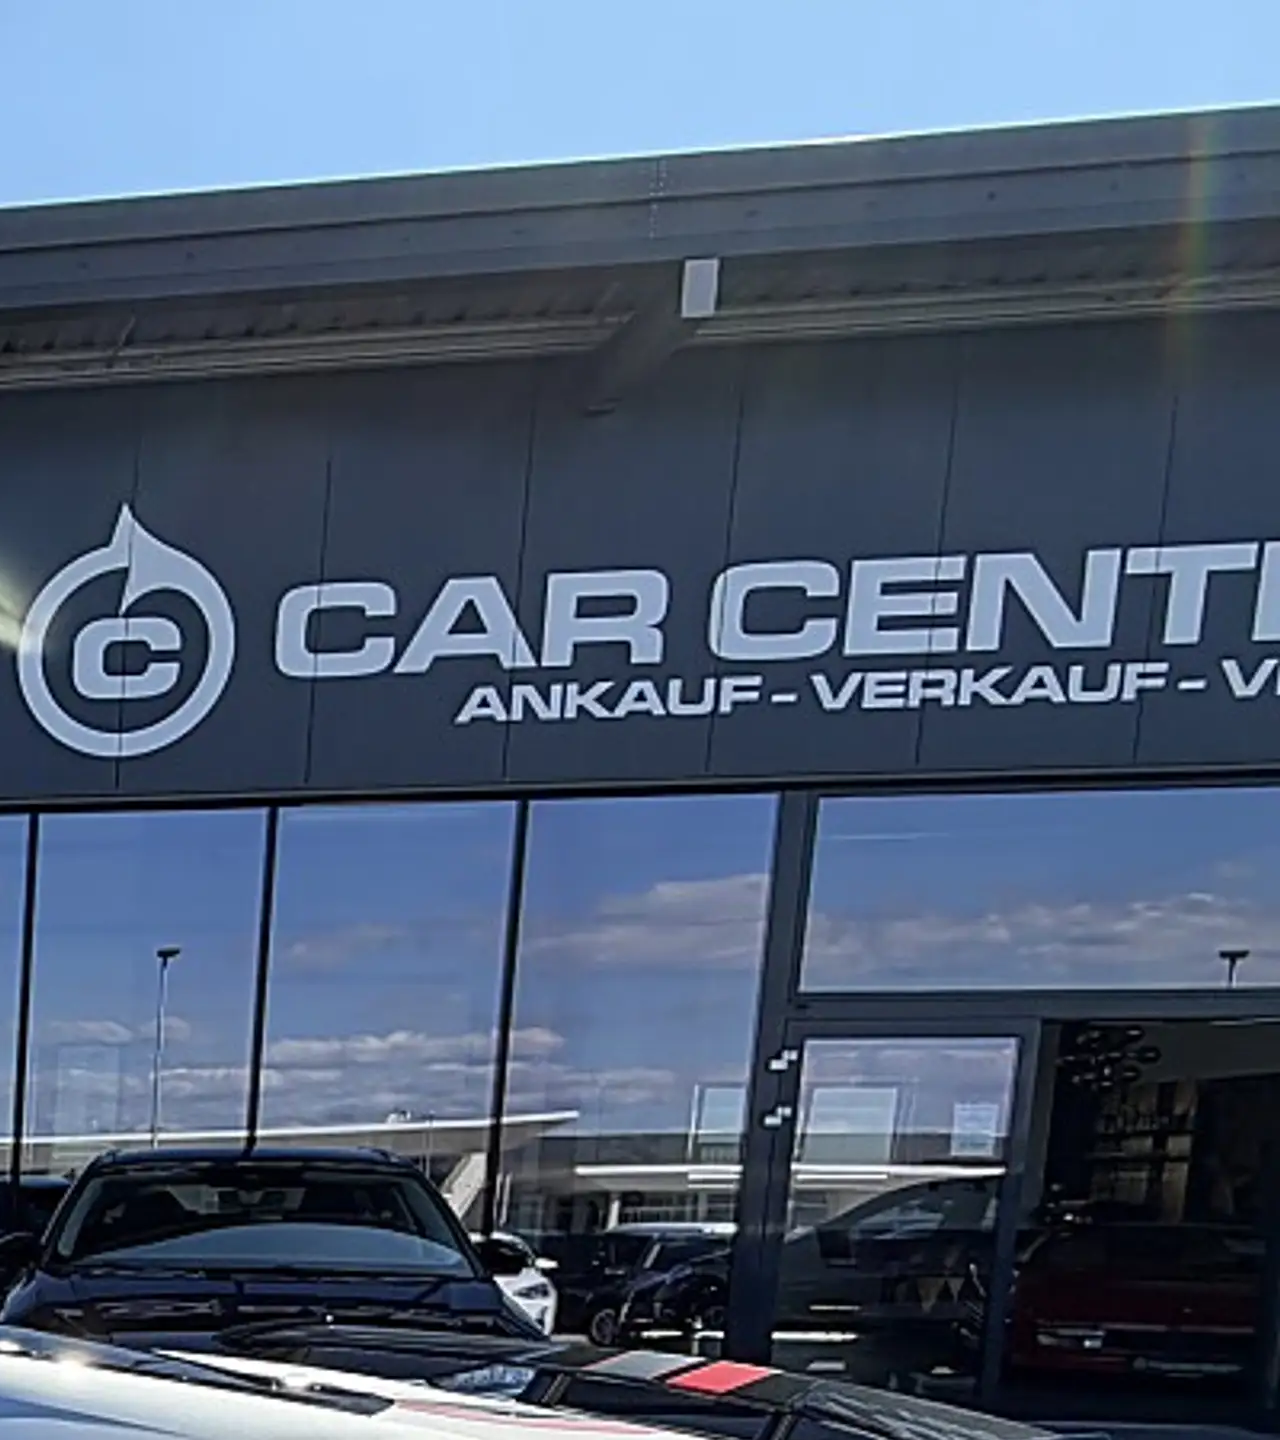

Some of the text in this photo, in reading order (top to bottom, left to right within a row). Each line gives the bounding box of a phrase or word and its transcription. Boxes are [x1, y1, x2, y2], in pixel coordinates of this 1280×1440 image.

[275, 568, 669, 678] CAR
[453, 673, 763, 723] ANKAUF
[813, 660, 1170, 711] VERKAUF
[1221, 657, 1280, 698] V
